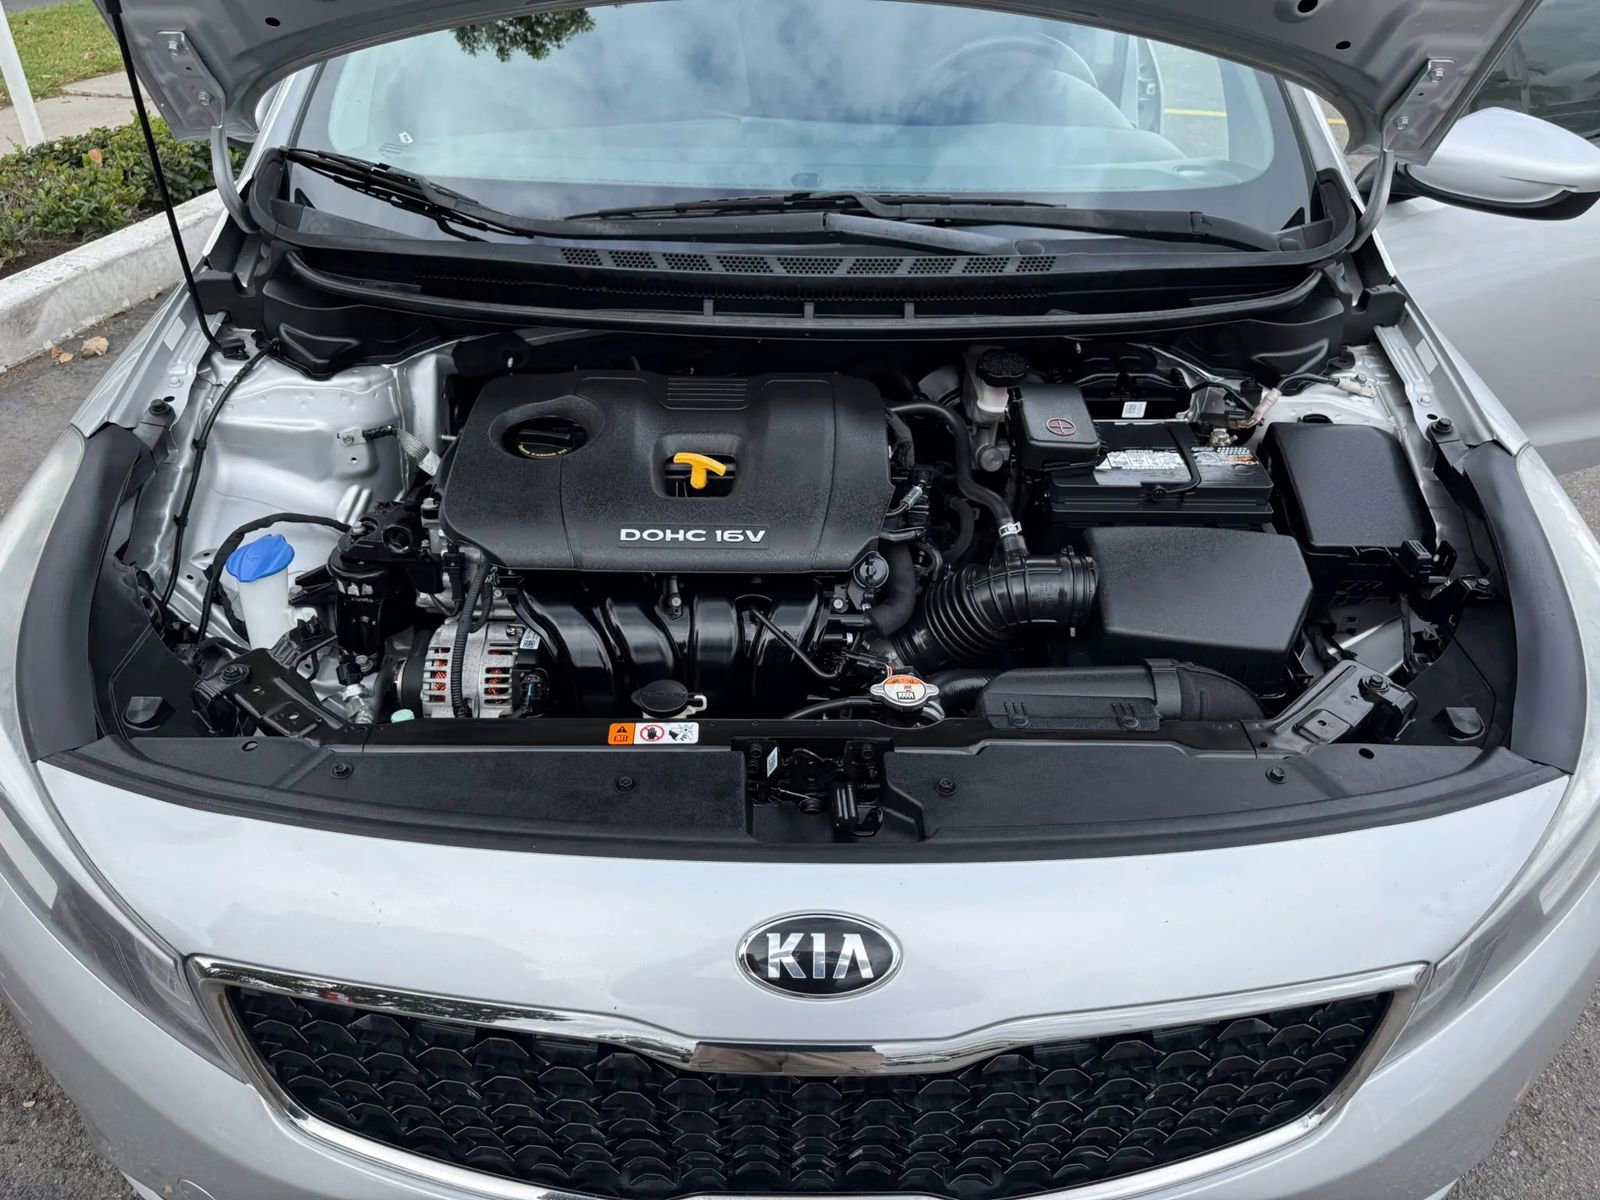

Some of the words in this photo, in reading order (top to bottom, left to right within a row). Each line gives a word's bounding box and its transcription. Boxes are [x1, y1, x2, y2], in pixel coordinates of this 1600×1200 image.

[620, 528, 707, 542] DOHC
[715, 529, 766, 543] 16V
[766, 932, 875, 979] KIA
